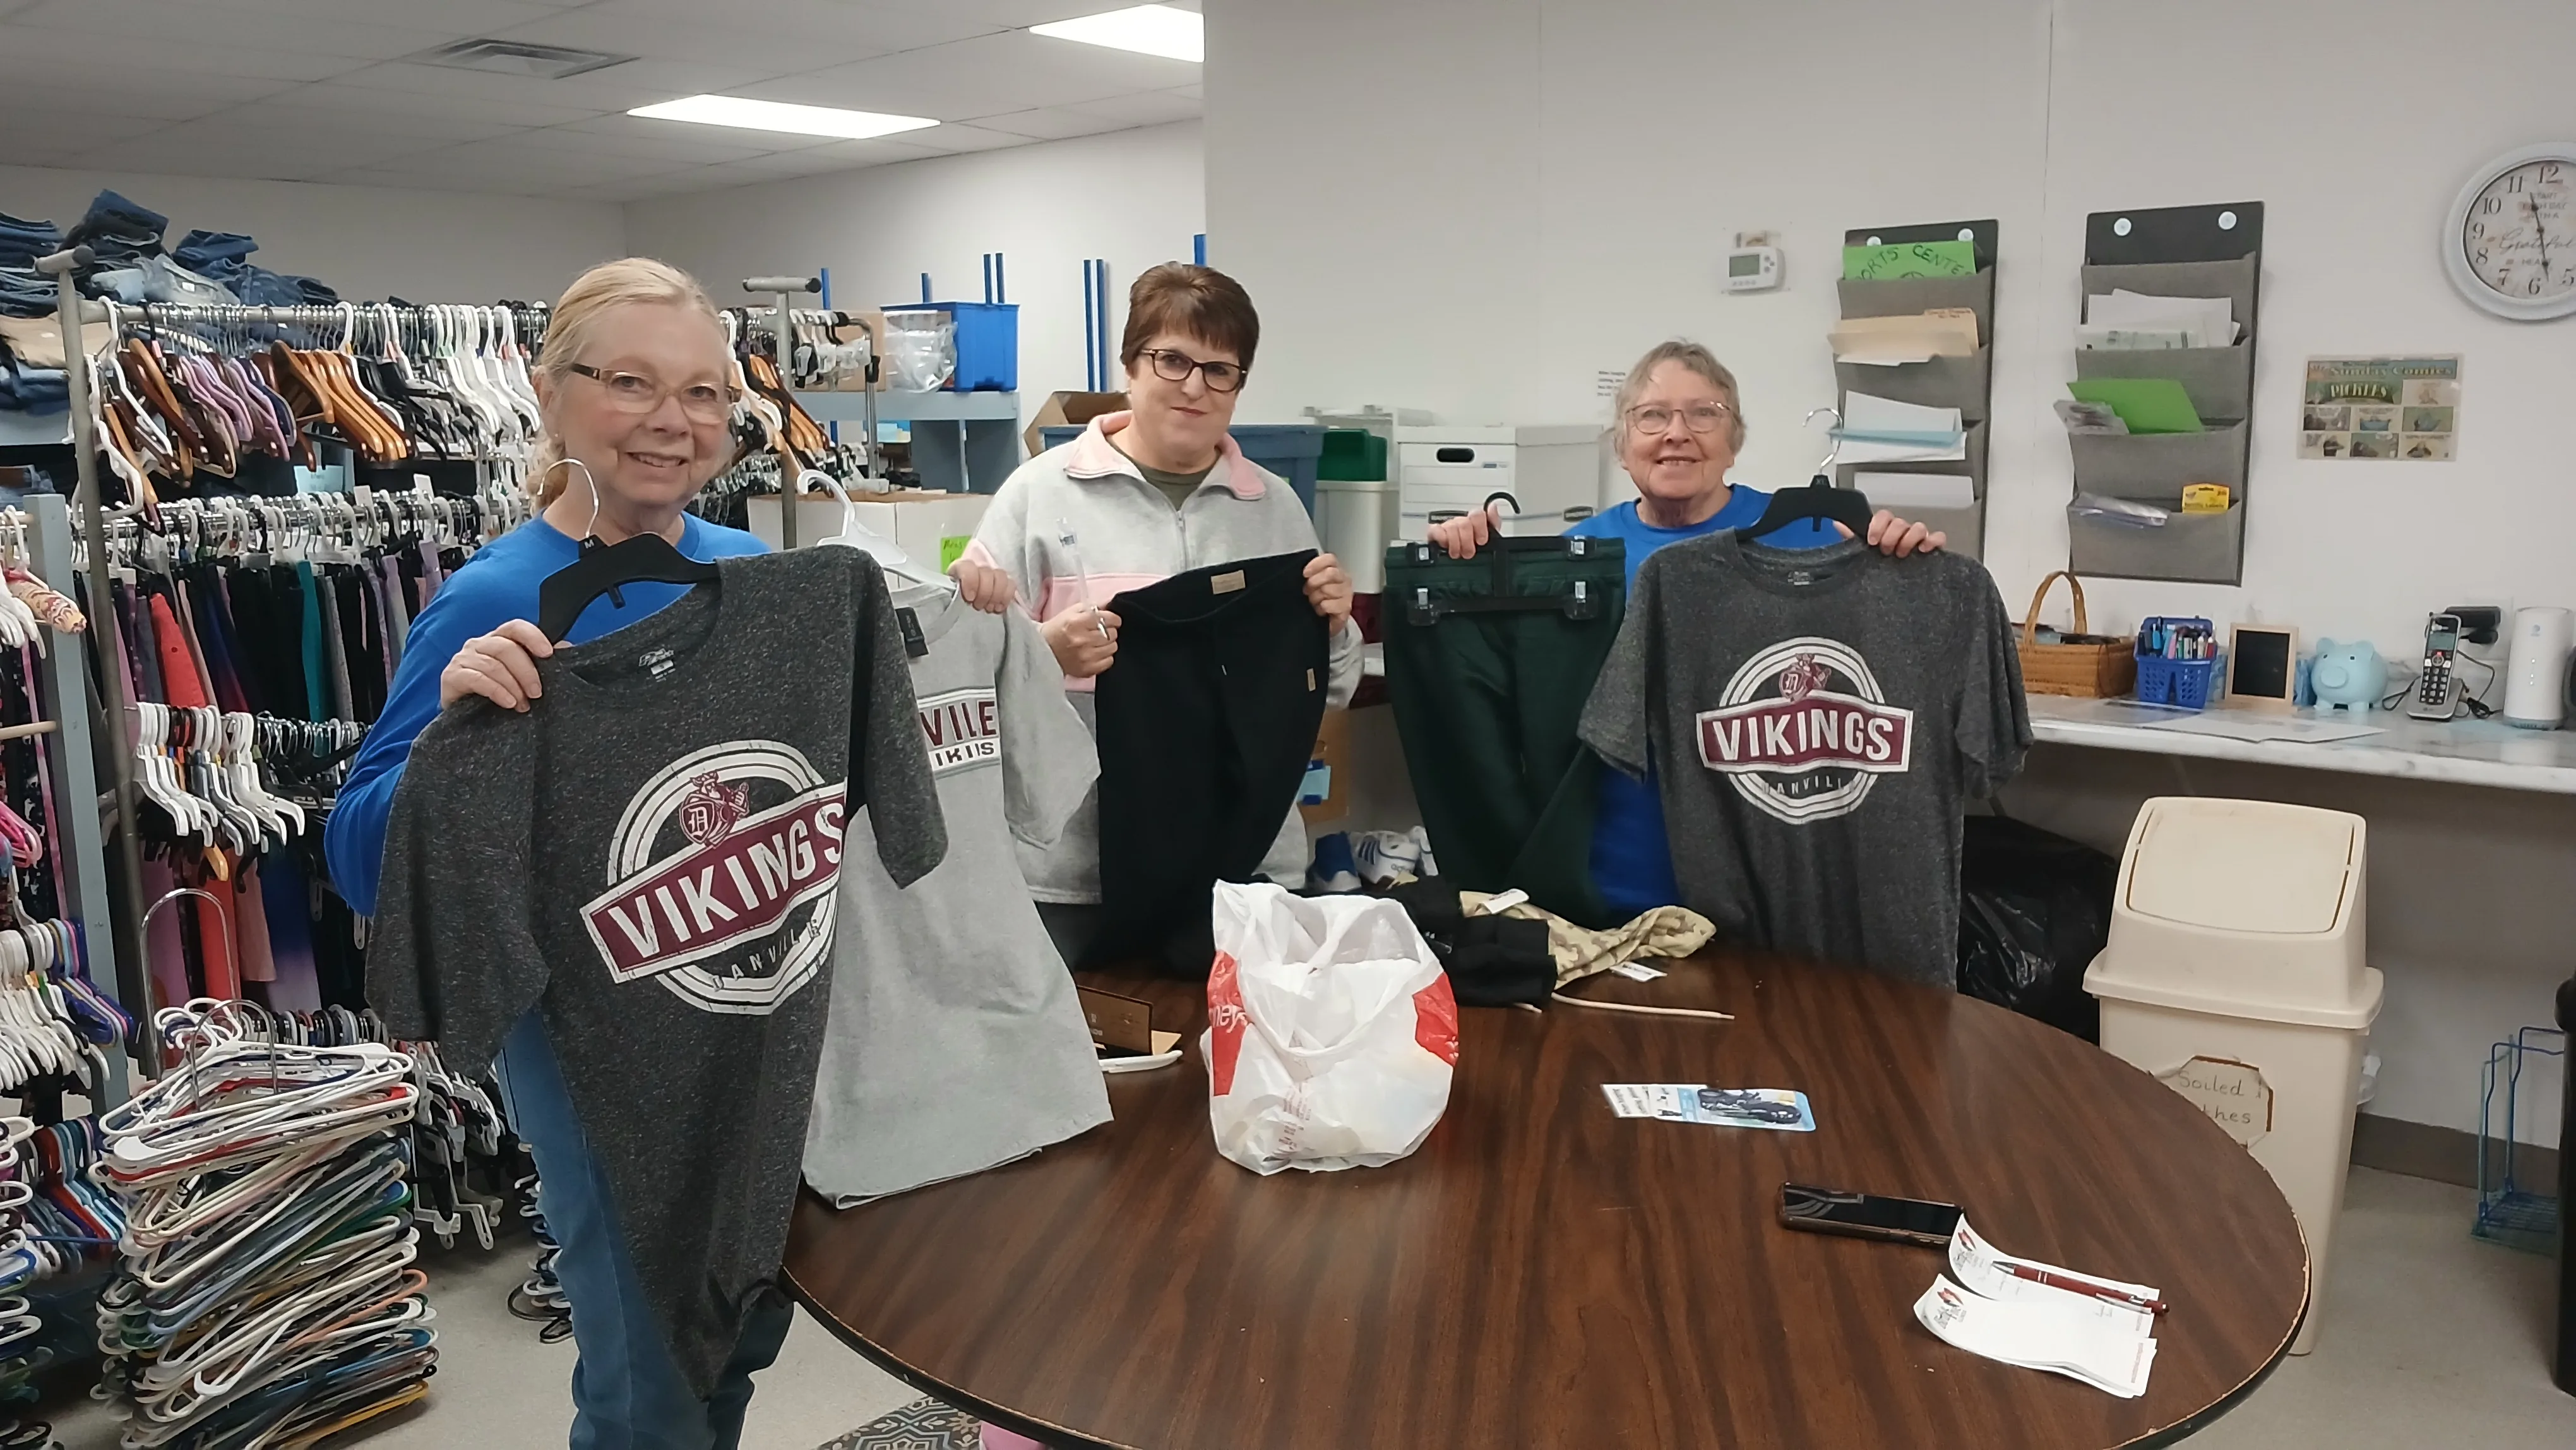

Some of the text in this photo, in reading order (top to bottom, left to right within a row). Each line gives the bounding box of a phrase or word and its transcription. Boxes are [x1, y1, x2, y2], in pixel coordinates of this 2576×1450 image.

[2539, 165, 2563, 184] 12
[2508, 176, 2524, 193] 11
[2483, 196, 2502, 215] 10
[2472, 222, 2485, 239] 9
[1854, 247, 1899, 280] ORTS
[2476, 248, 2488, 265] 8
[2498, 268, 2511, 285] 7
[2561, 268, 2575, 286] 5
[2528, 277, 2541, 295] 6
[584, 539, 595, 549] M
[1712, 709, 1893, 761] VIKINGS
[607, 803, 845, 959] VIKINGS
[2178, 1070, 2245, 1096] Soiled
